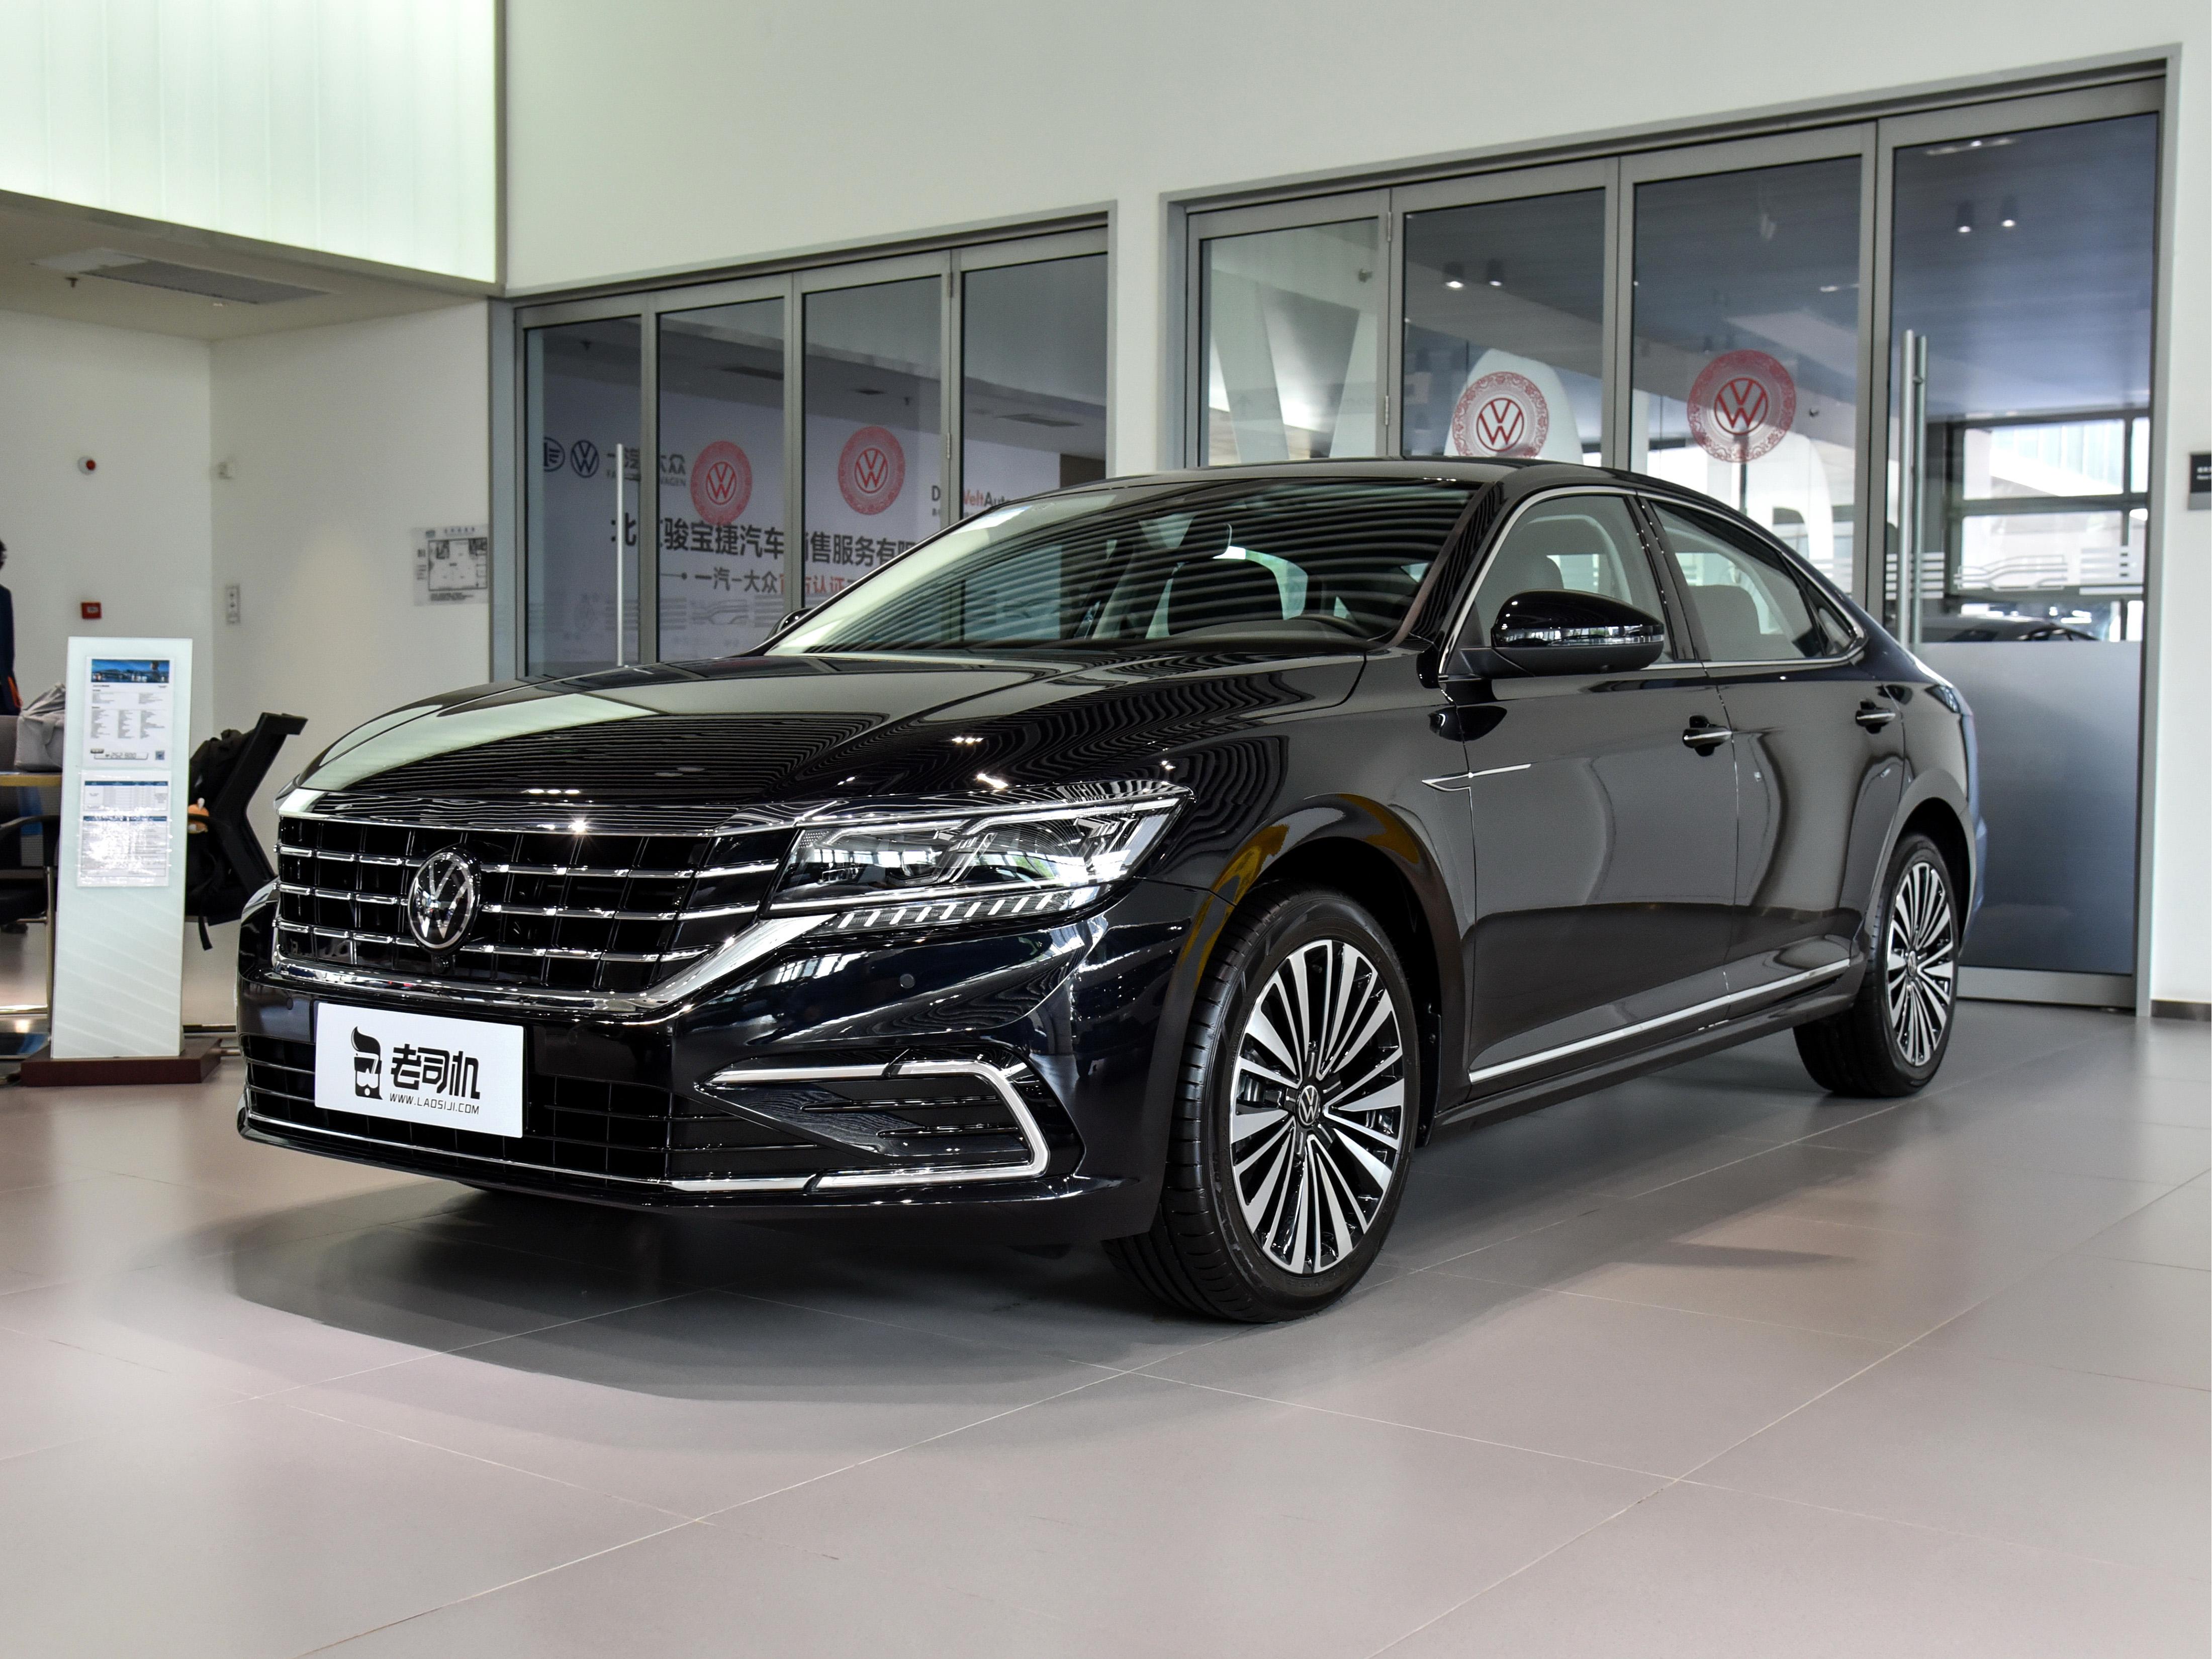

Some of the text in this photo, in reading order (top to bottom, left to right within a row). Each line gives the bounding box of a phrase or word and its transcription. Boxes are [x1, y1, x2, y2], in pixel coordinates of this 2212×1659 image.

[391, 1044, 481, 1100] 老司机
[390, 1092, 480, 1115] WWW.LAOSIJI.COM
